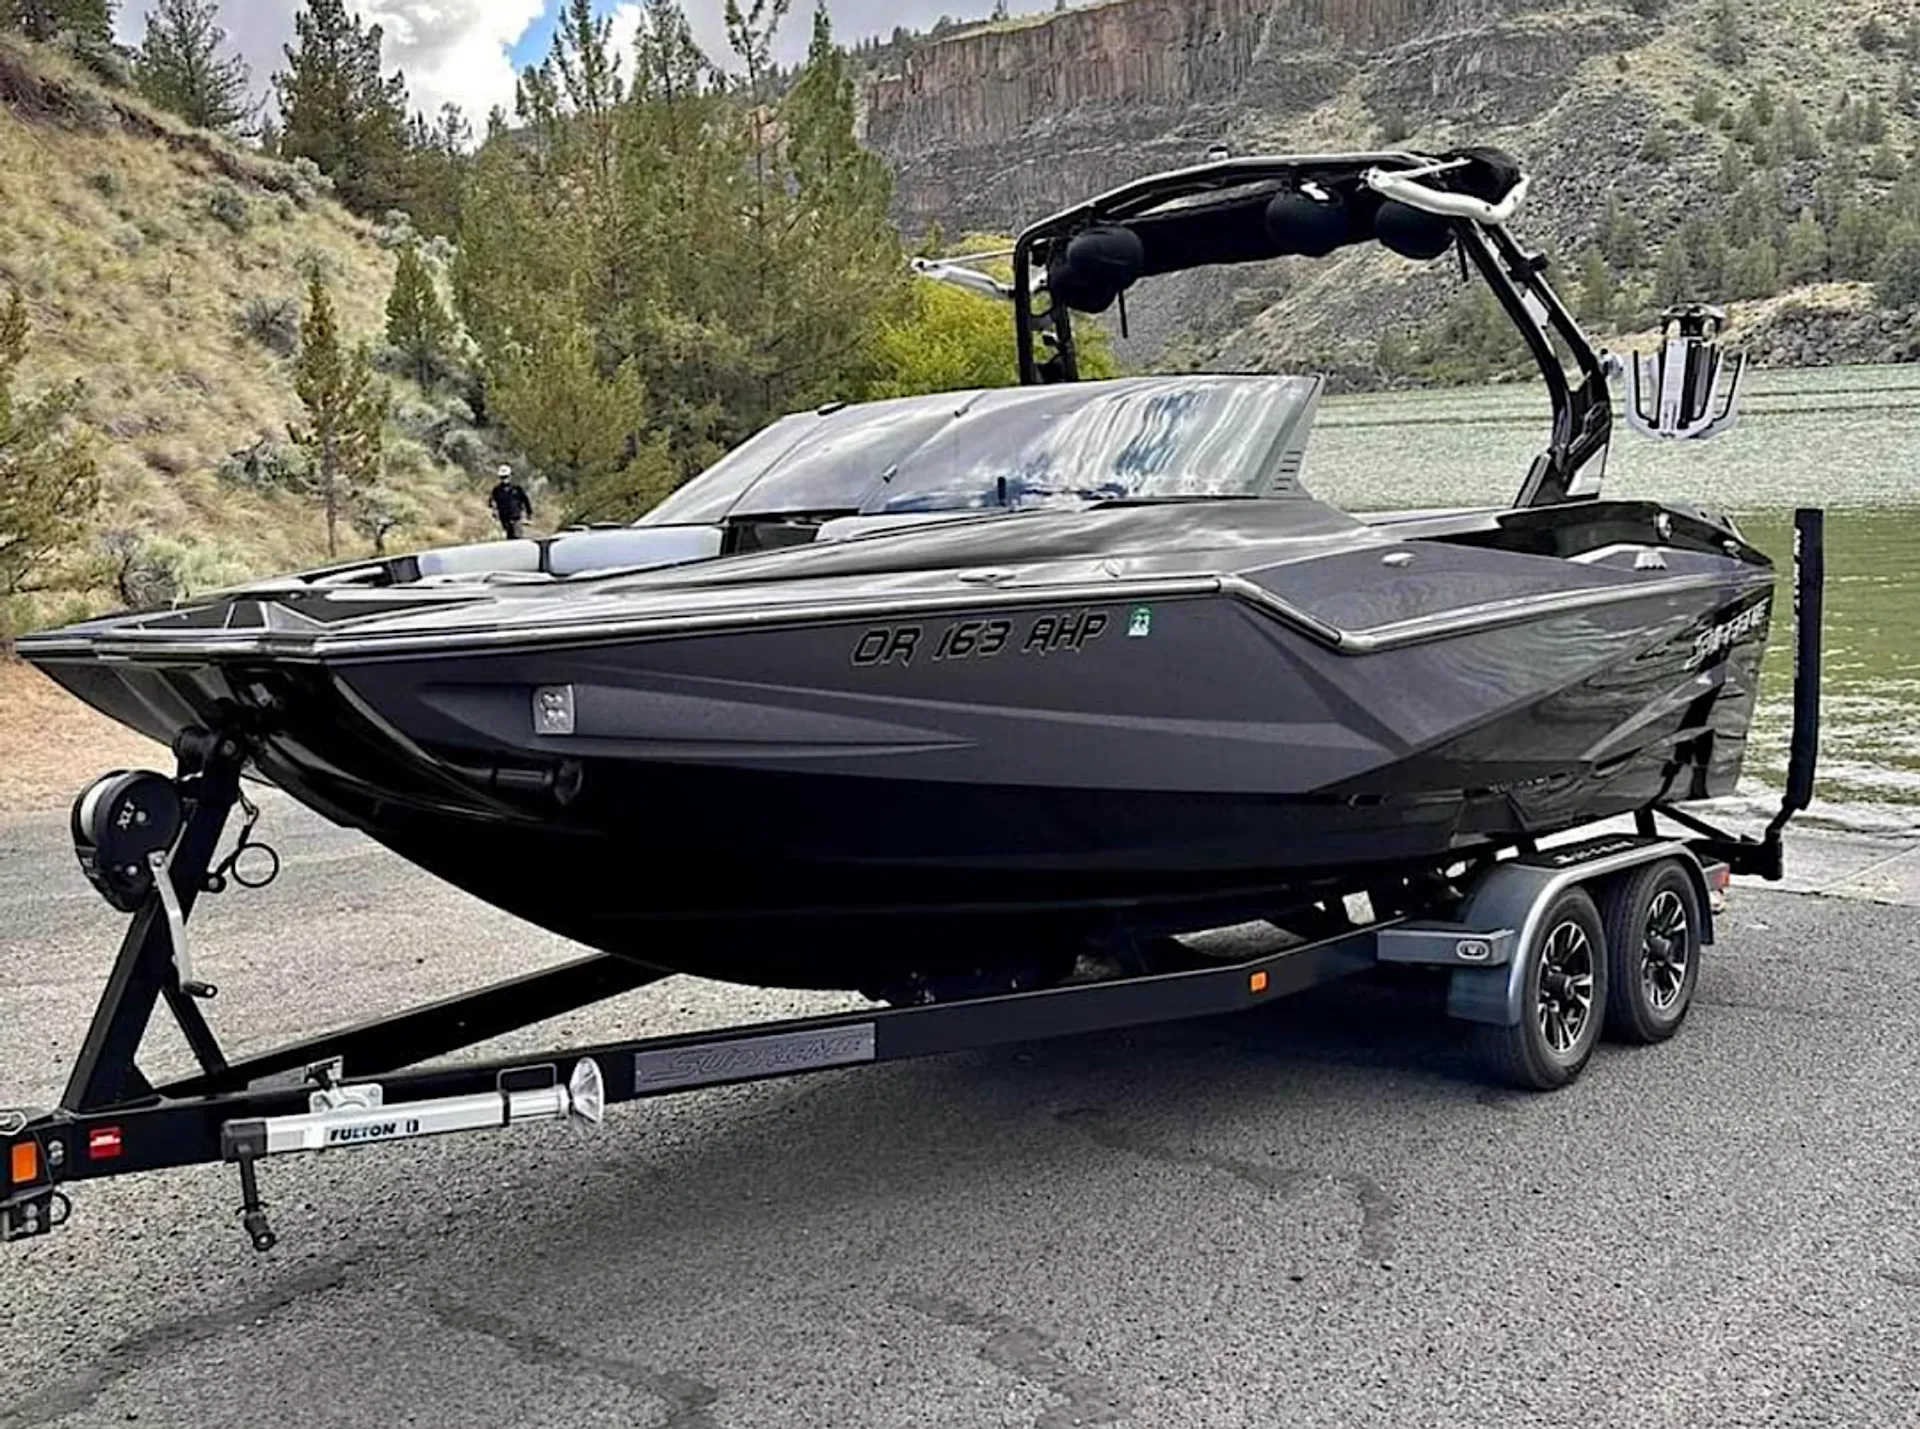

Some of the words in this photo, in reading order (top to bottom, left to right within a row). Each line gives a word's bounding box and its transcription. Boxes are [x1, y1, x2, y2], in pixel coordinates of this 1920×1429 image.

[851, 624, 923, 668] OR
[932, 617, 1012, 661] 163
[1021, 607, 1108, 656] AHP
[330, 1123, 397, 1141] FULTON
